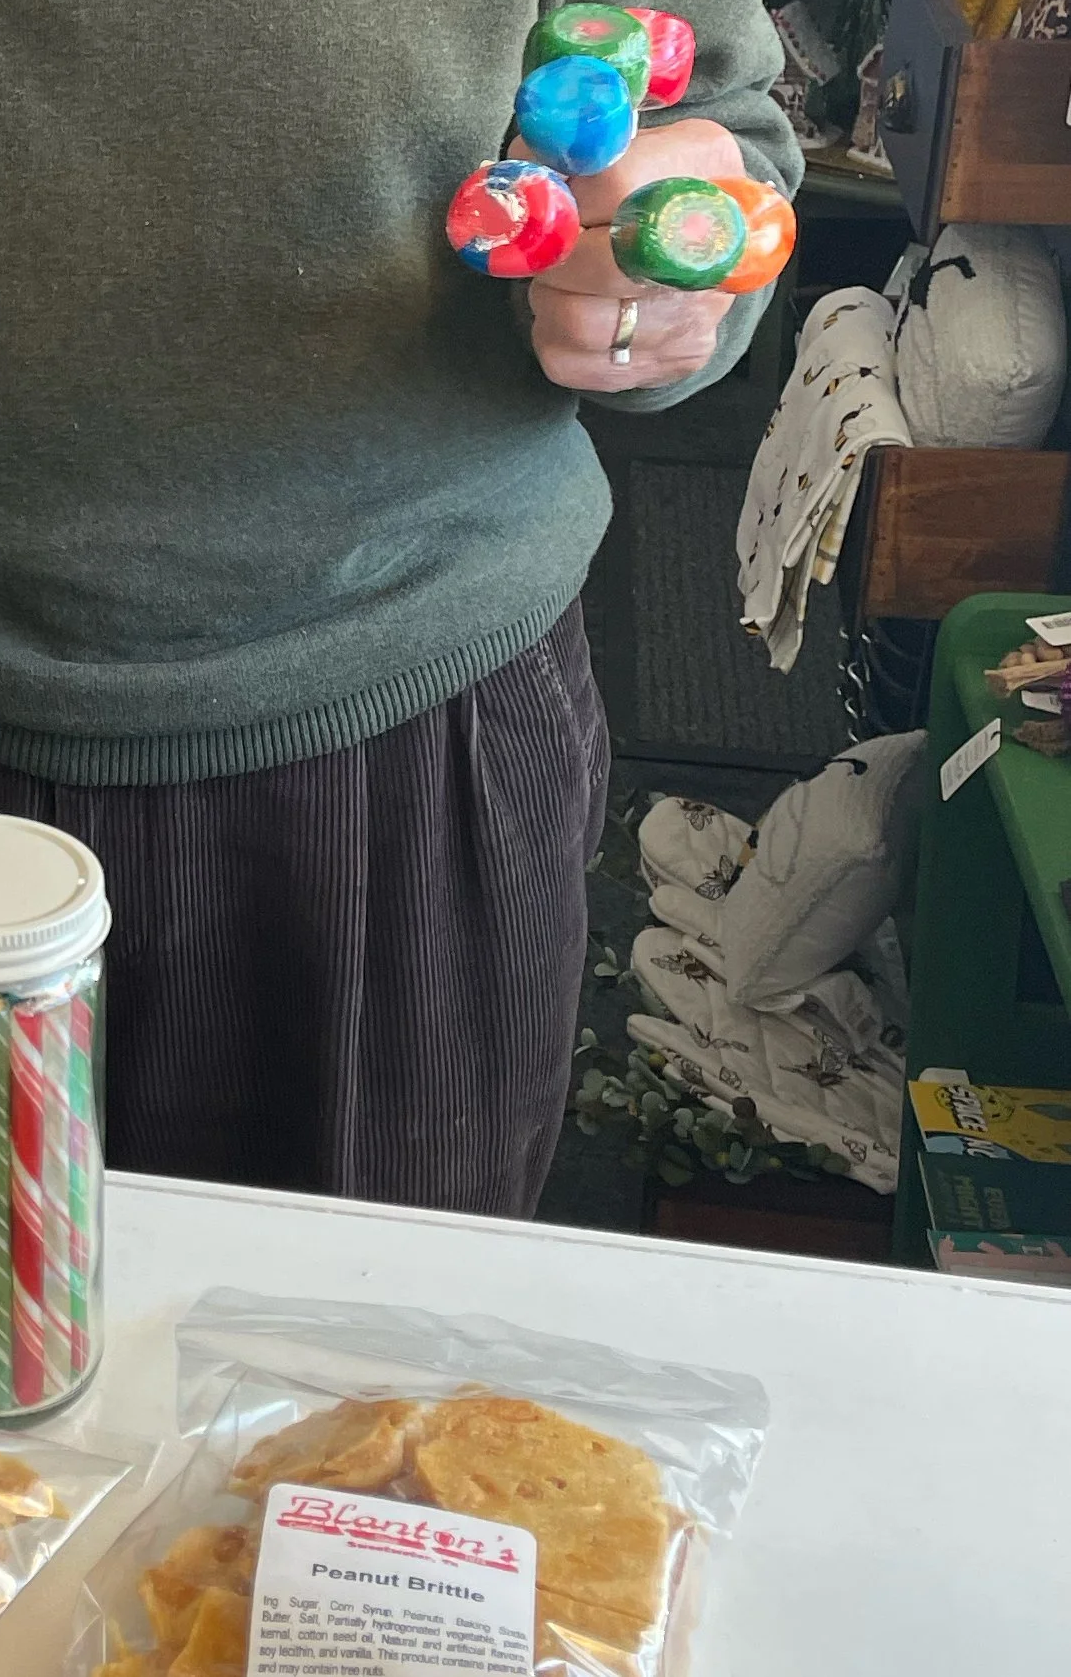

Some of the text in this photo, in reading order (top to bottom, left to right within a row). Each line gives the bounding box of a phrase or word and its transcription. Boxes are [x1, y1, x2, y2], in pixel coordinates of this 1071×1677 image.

[280, 1495, 520, 1563] Blanton's
[311, 1563, 486, 1603] Peanut Brittle
[327, 1614, 367, 1630] Partially
[298, 1629, 328, 1641] cotton
[333, 1631, 357, 1643] seed
[381, 1634, 417, 1648] Natural
[423, 1641, 441, 1651] and
[446, 1643, 486, 1656] artificial
[258, 1663, 277, 1673] and
[279, 1664, 300, 1677] may
[302, 1664, 339, 1675] contain
[340, 1665, 360, 1675] tree
[259, 1646, 277, 1659] soy
[319, 1646, 338, 1658] and
[377, 1648, 399, 1661] This
[401, 1652, 439, 1665] product
[441, 1657, 485, 1670] contains
[488, 1662, 528, 1676] peanuts
